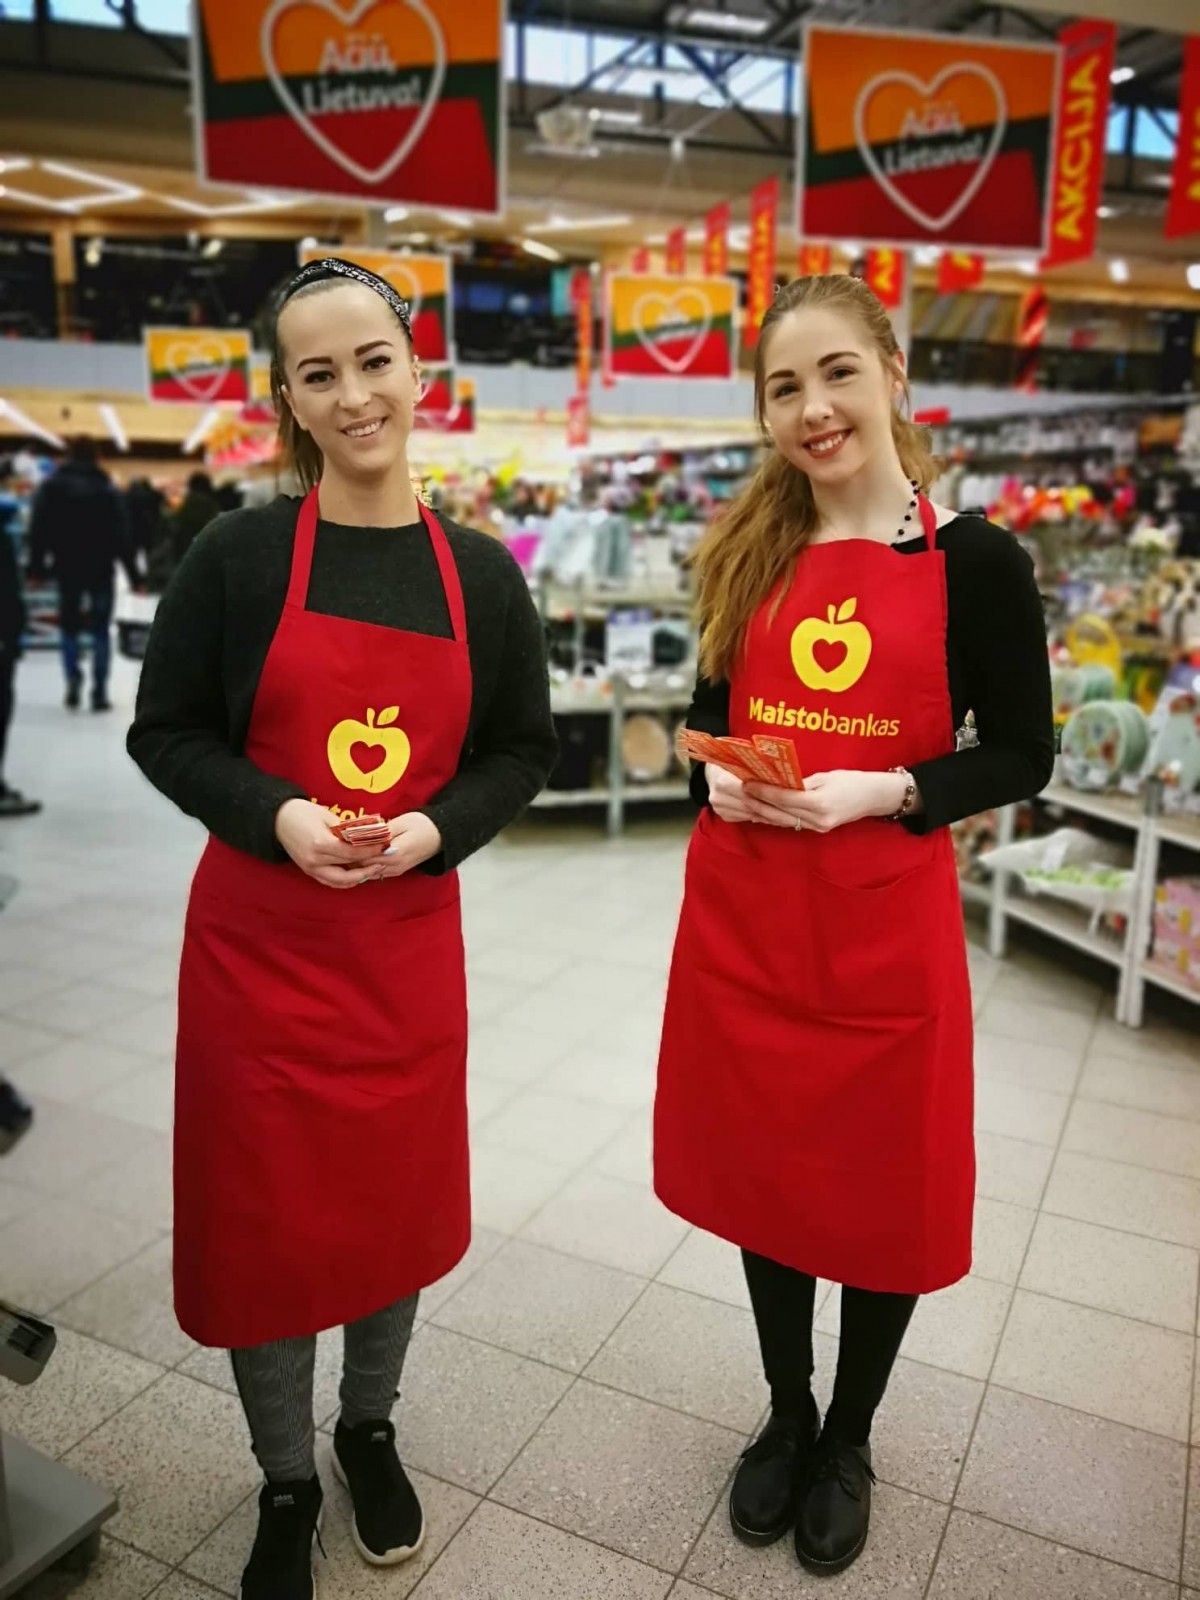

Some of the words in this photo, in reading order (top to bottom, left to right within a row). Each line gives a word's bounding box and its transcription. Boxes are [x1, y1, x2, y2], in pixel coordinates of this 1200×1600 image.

[302, 75, 421, 115] Lietuva!
[1054, 56, 1100, 241] AKCIJA
[749, 696, 900, 738] Maistobankas
